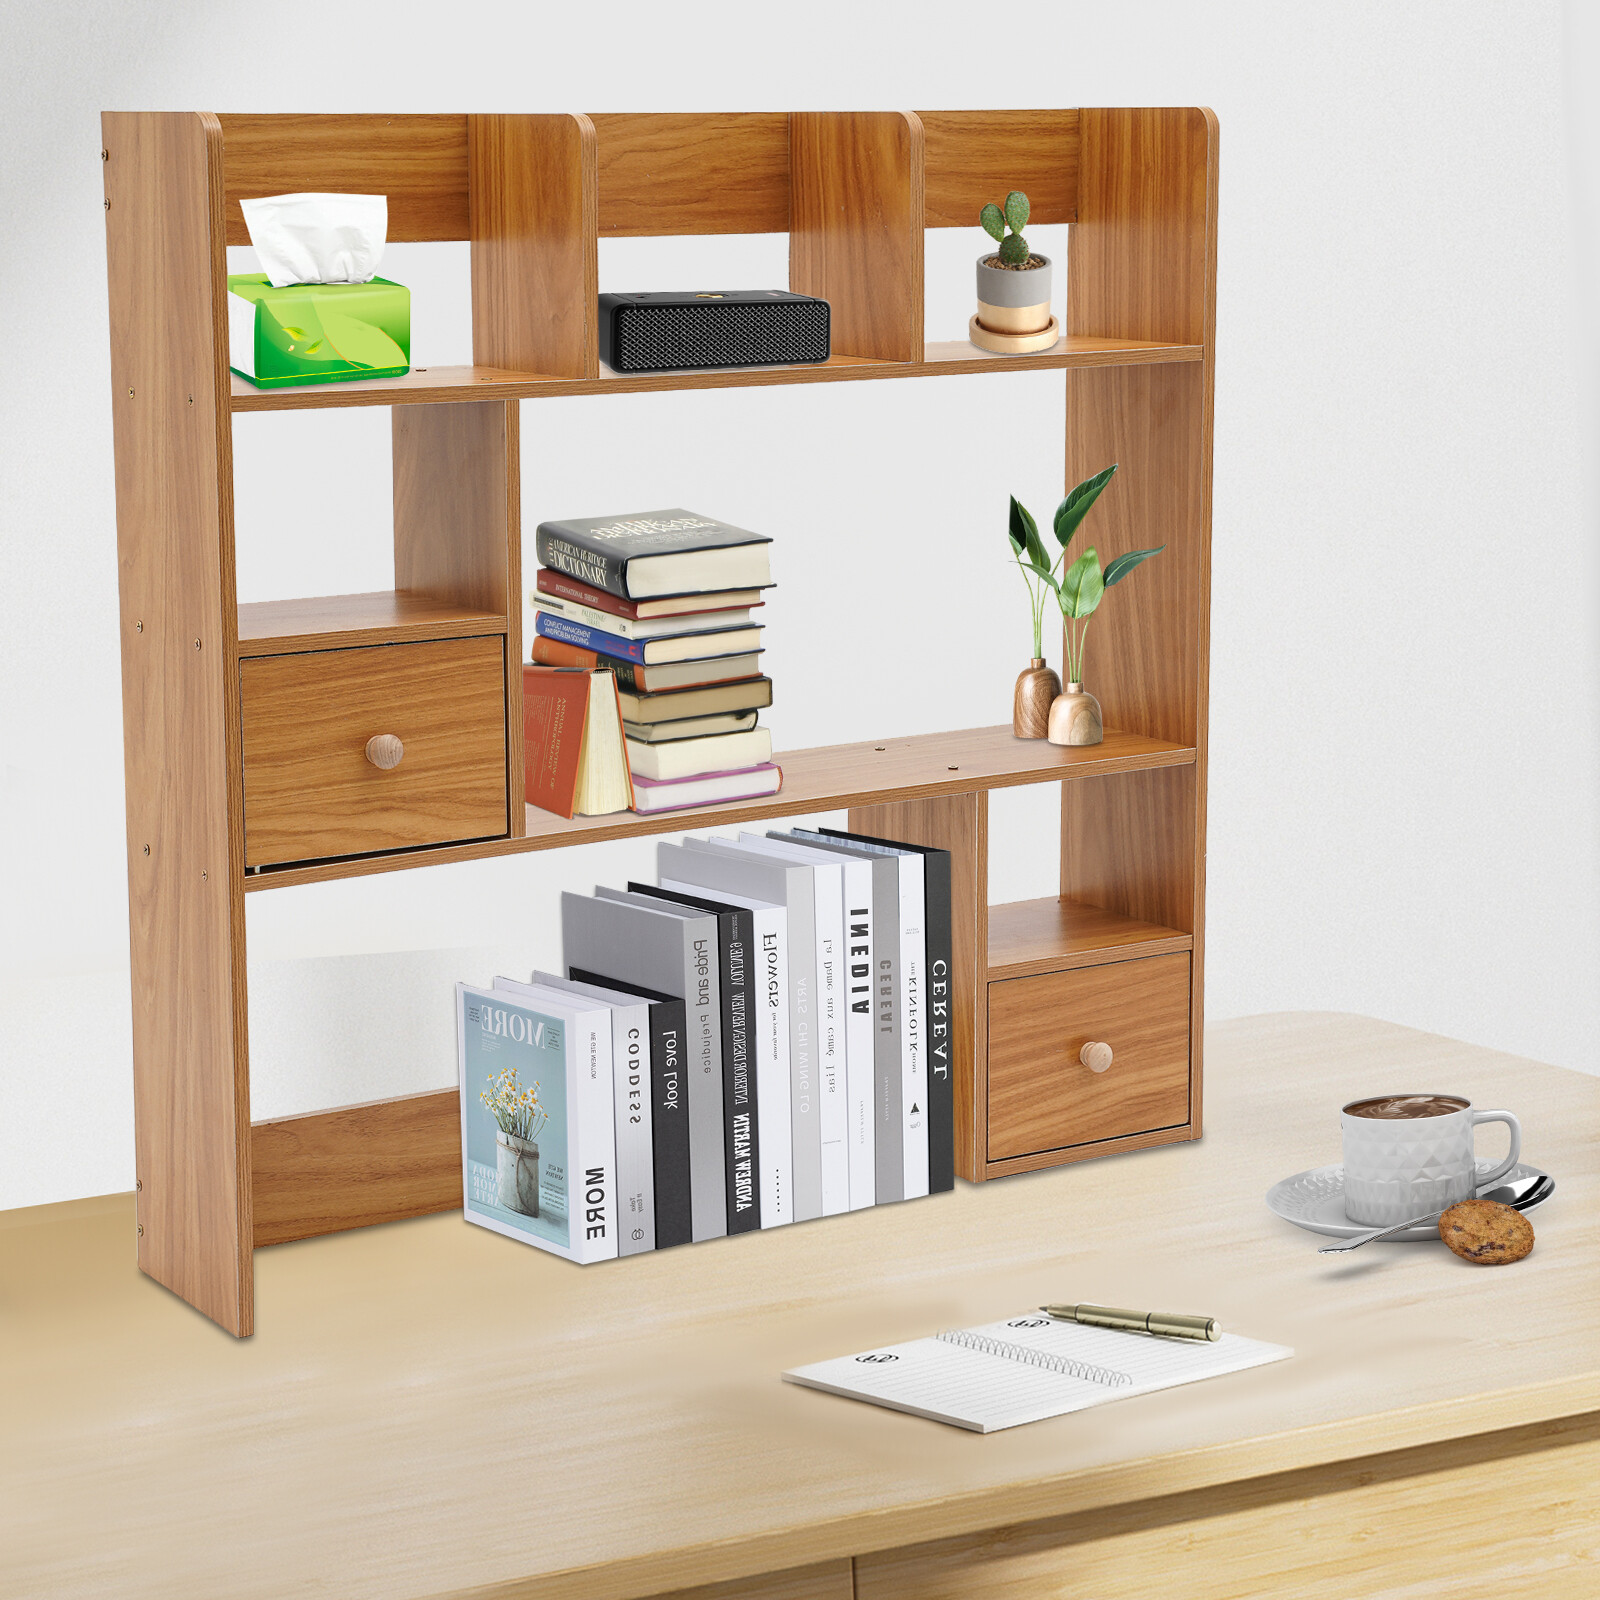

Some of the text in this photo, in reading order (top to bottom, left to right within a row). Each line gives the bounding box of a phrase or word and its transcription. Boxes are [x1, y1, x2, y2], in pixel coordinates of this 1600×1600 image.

[553, 539, 580, 558] AMERICAN
[580, 549, 608, 569] HERITAGE
[553, 550, 607, 587] DICTIONARY
[555, 584, 599, 603] INTERNATIONAL THEORY
[543, 619, 591, 639] CONFLICT MANAGEMENT
